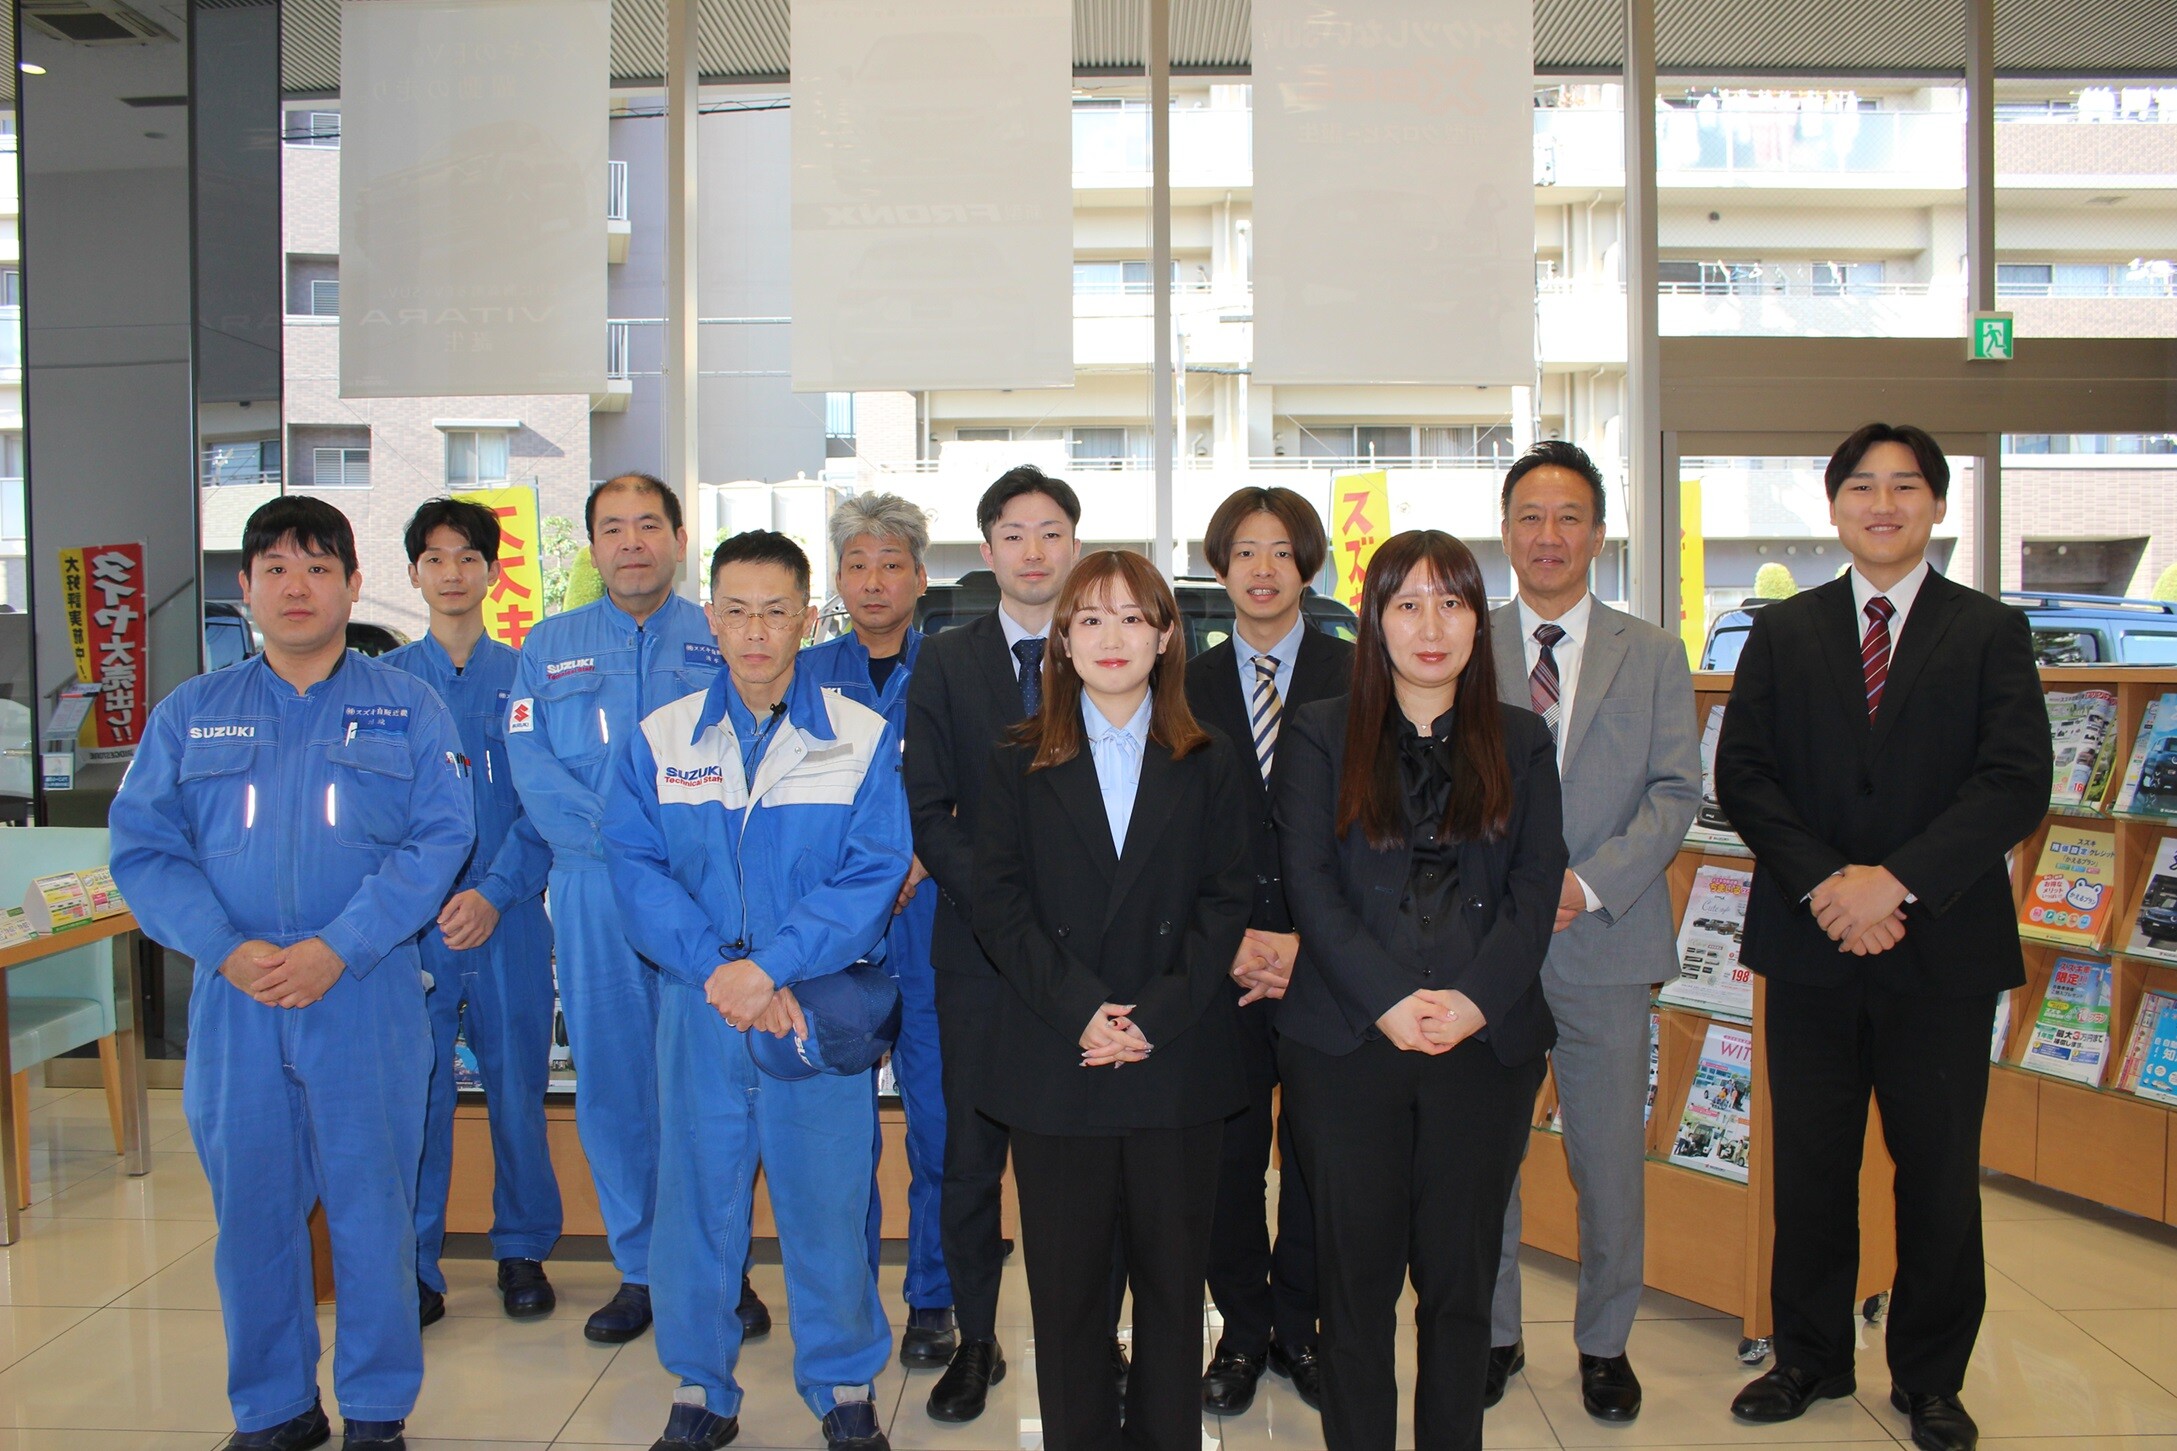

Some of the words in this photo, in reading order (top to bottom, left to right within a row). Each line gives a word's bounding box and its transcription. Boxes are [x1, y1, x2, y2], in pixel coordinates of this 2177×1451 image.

[546, 658, 595, 674] SUZUKI
[189, 726, 255, 739] SUZUKI
[666, 766, 723, 781] SUZUKI
[664, 776, 702, 787] Technical
[1731, 969, 1750, 982] 198
[1721, 1041, 1752, 1061] WIT
